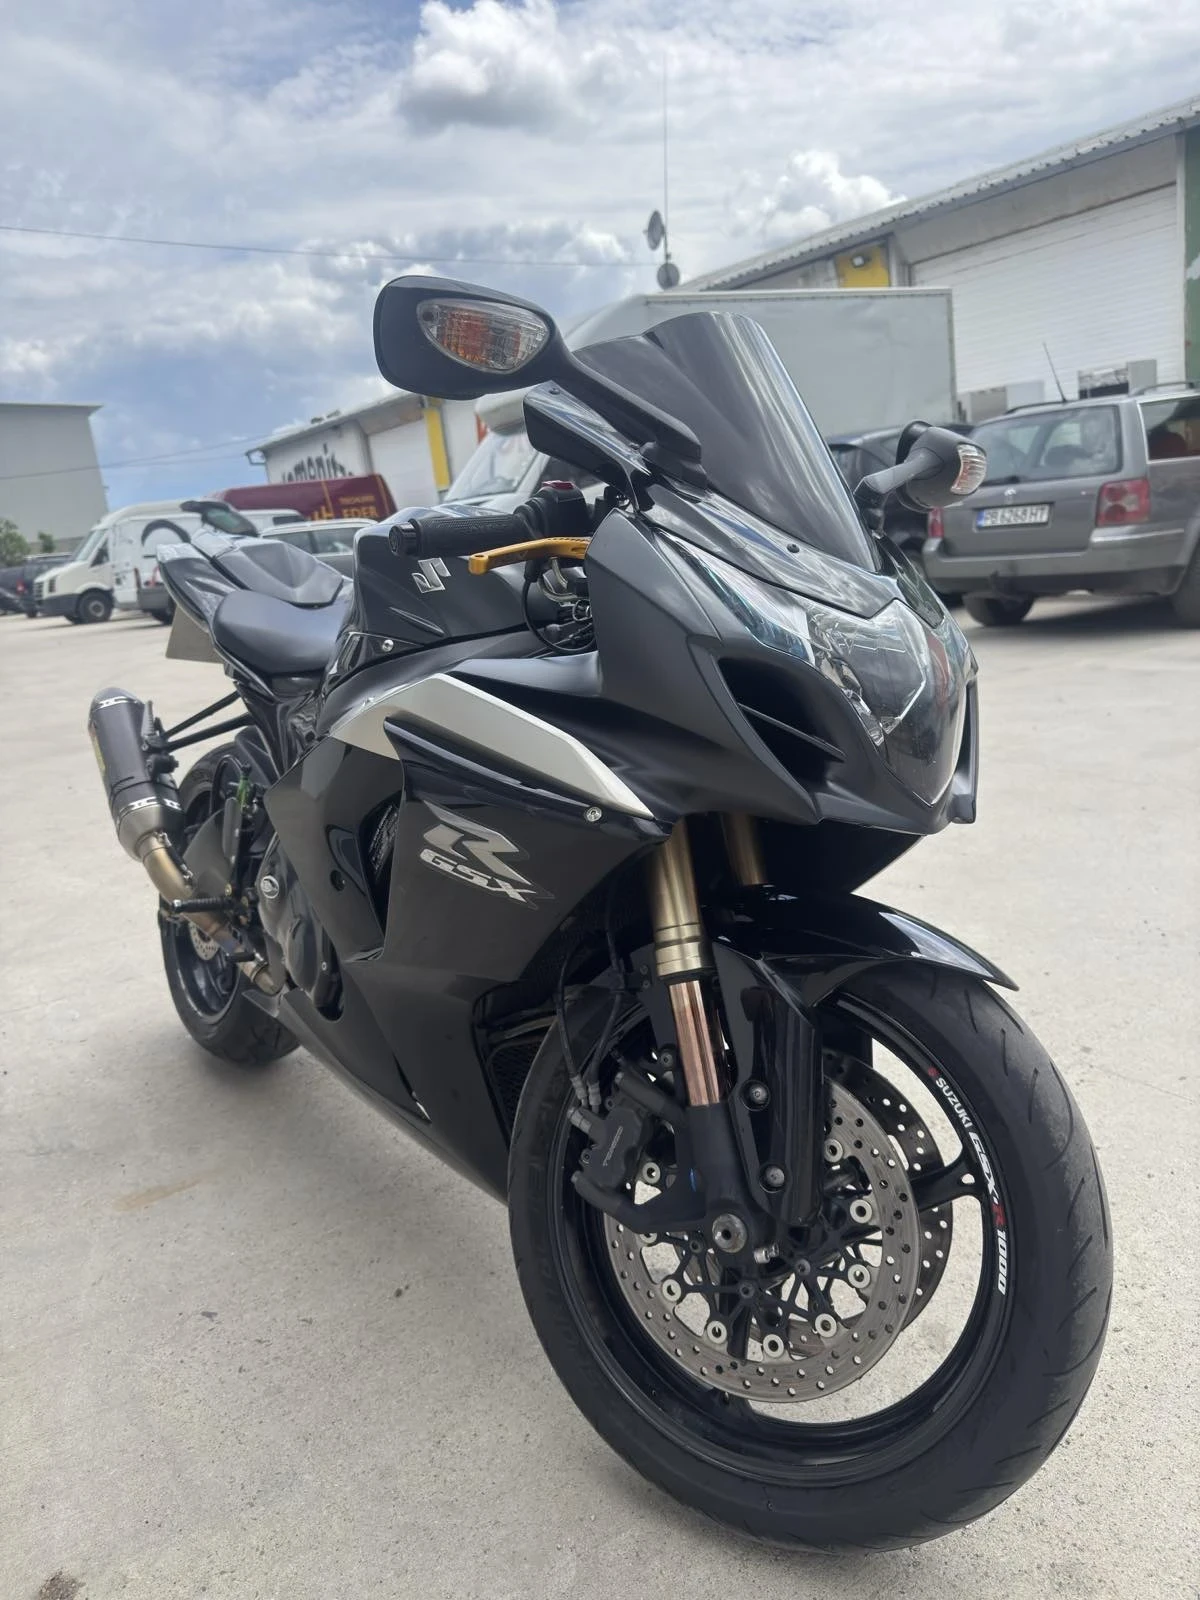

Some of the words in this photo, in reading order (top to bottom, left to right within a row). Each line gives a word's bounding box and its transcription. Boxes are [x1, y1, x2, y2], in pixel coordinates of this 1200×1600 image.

[423, 800, 532, 885] R
[420, 848, 537, 903] GSX
[936, 1077, 973, 1128] SUZUKI
